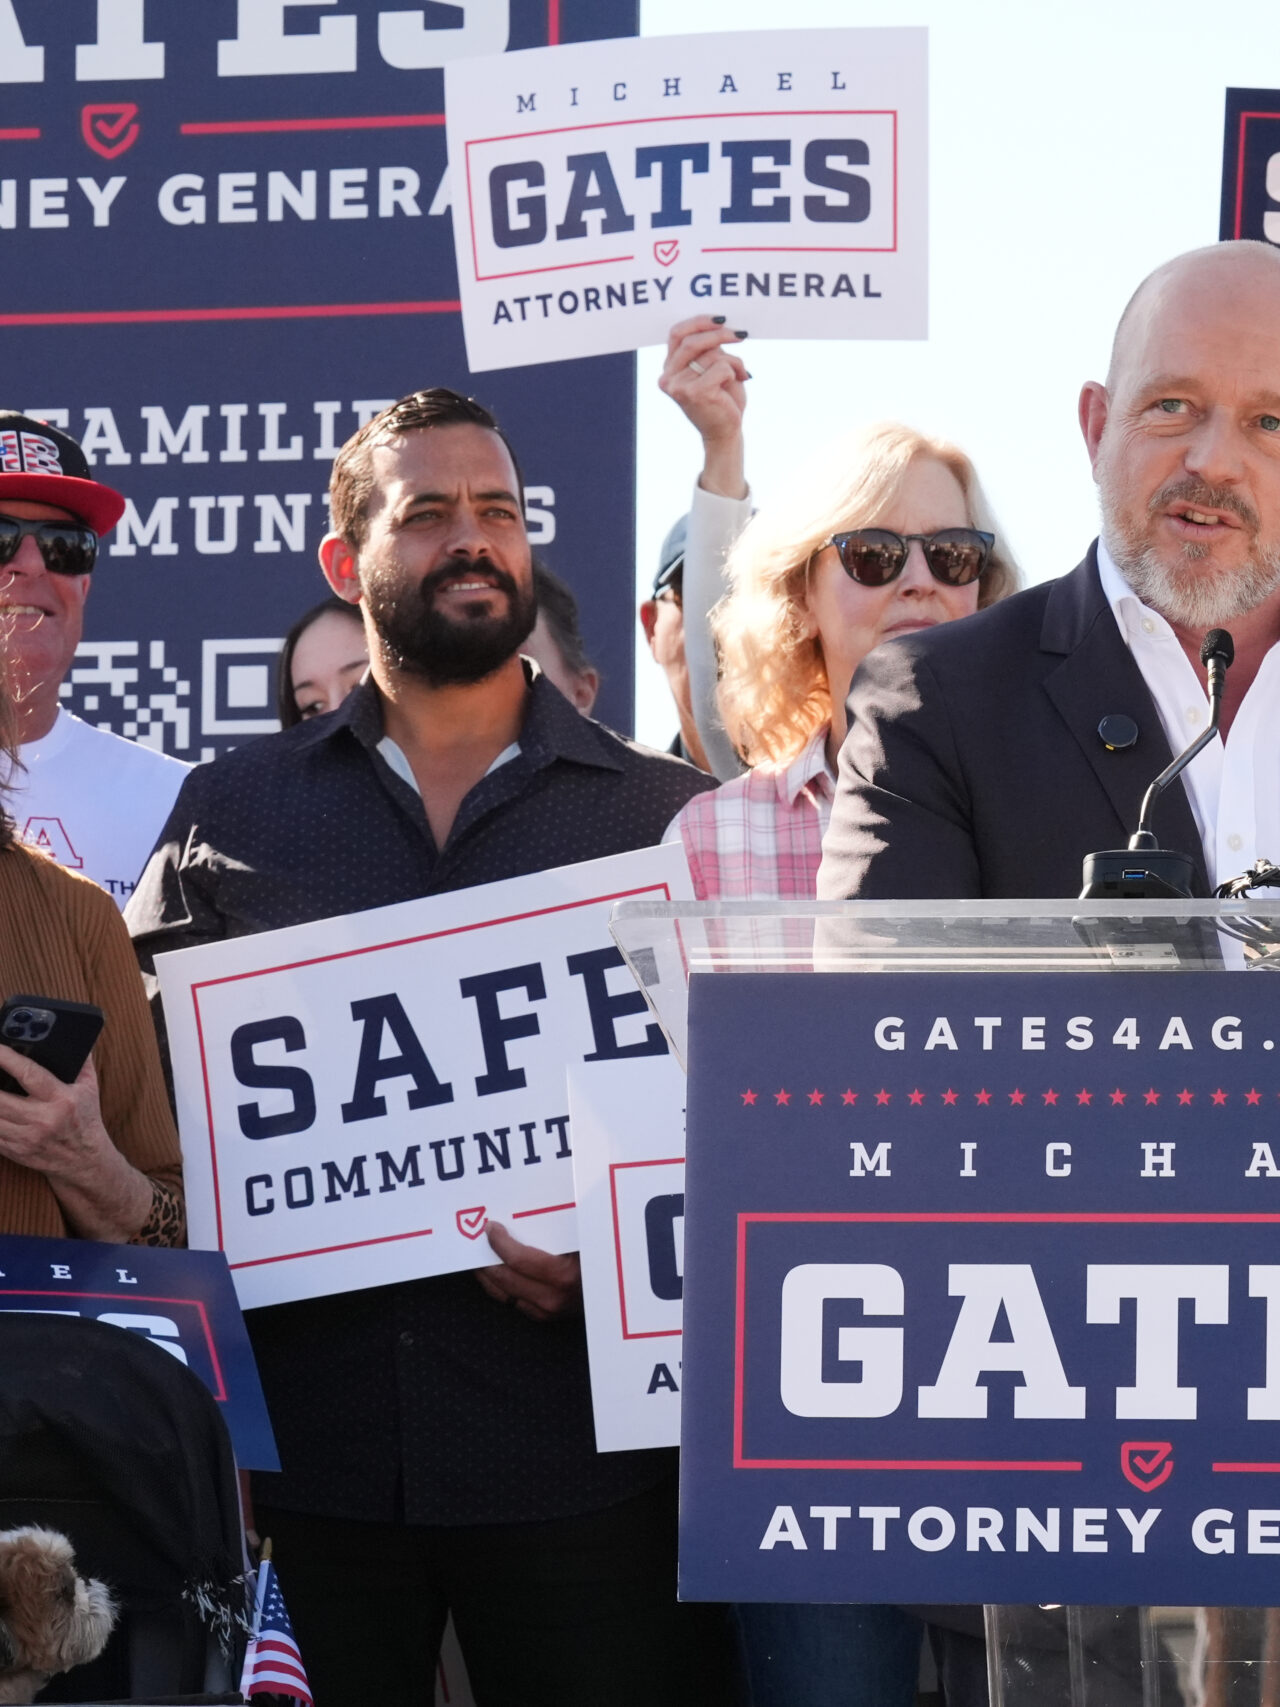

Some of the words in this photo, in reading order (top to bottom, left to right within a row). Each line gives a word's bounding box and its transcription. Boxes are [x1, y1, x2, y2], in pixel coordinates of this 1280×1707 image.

[516, 71, 846, 113] MICHAEL
[489, 138, 871, 249] GATES
[492, 276, 673, 325] ATTORNEY
[690, 273, 882, 299] GENERAL
[230, 946, 669, 1140] SAFE
[759, 1505, 1162, 1553] ATTORNEY
